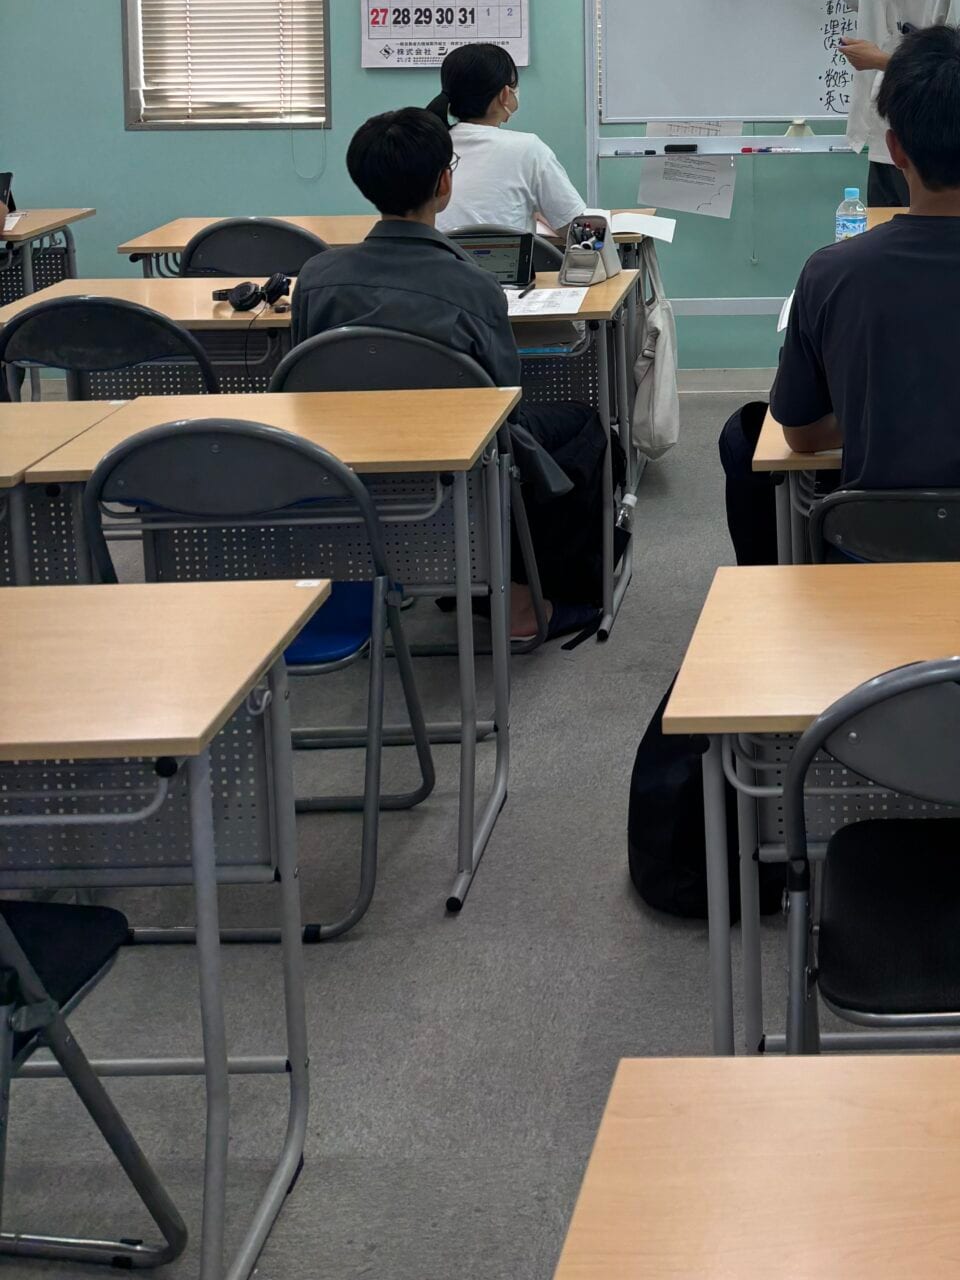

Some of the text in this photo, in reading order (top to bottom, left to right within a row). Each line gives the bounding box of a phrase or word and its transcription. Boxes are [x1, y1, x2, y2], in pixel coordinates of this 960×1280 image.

[370, 8, 512, 25] 27 28 29 30 31 1 2
[396, 48, 431, 56] 株式会社
